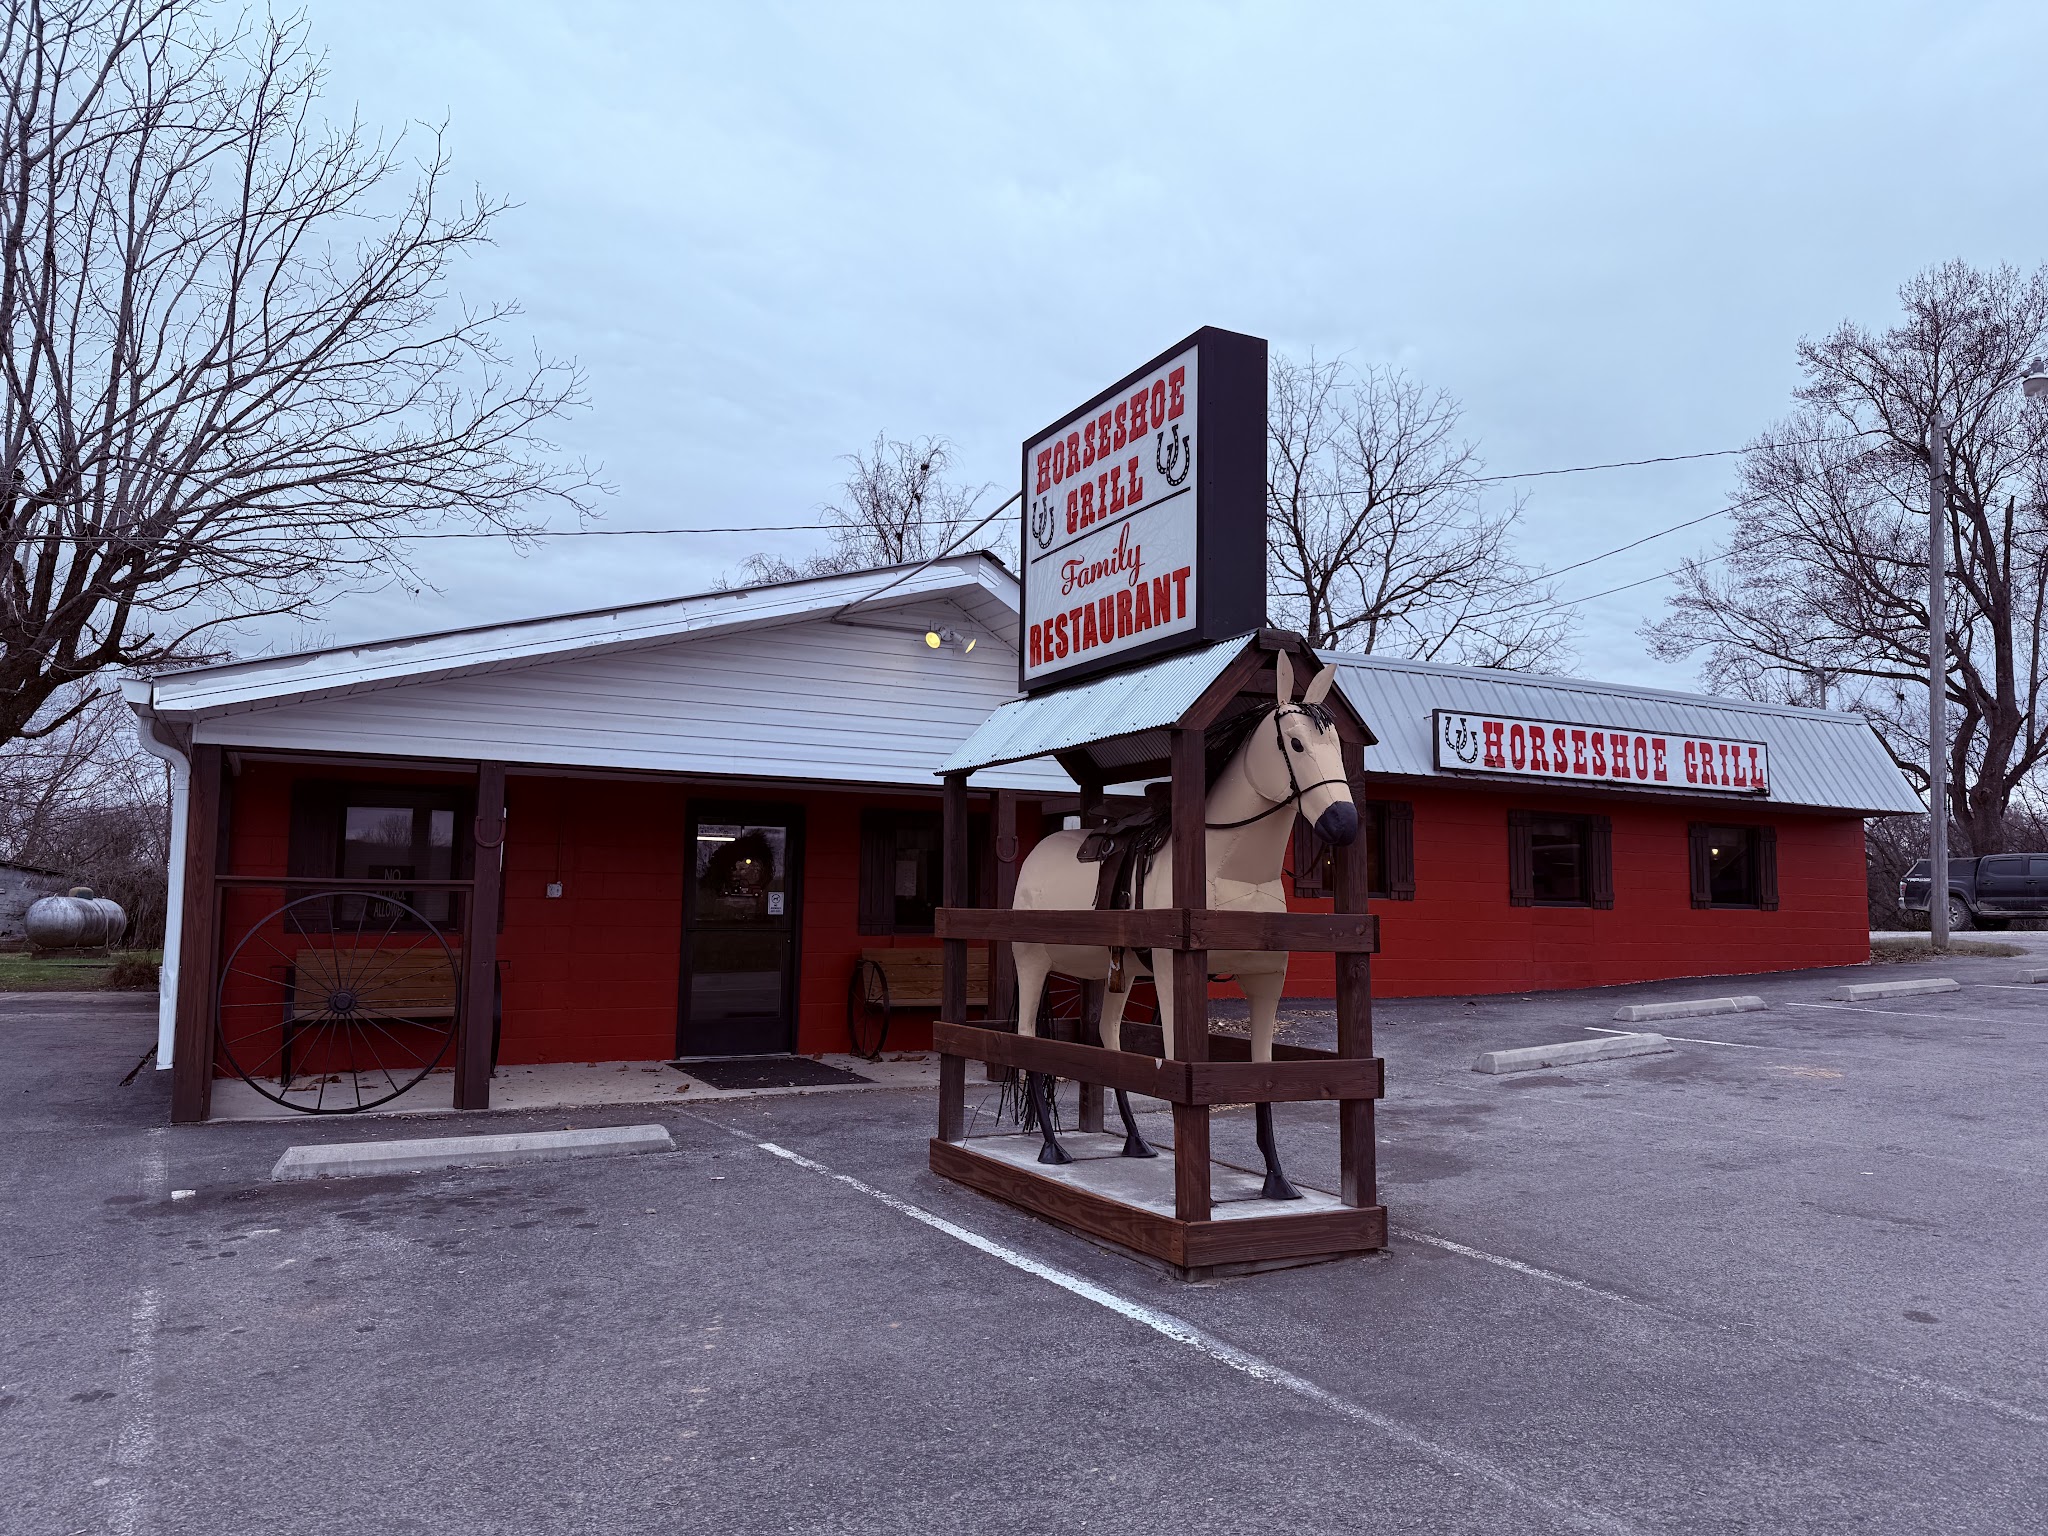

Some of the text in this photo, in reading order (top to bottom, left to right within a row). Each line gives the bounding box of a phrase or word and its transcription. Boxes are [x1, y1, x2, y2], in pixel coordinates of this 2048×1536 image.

[1036, 365, 1185, 495] HORSESHOE
[1066, 455, 1143, 535] GRILL
[1061, 522, 1146, 596] Family
[1029, 566, 1190, 668] RESTAURANT
[1482, 720, 1765, 788] HORSESHOE GRILL
[385, 869, 401, 880] NO
